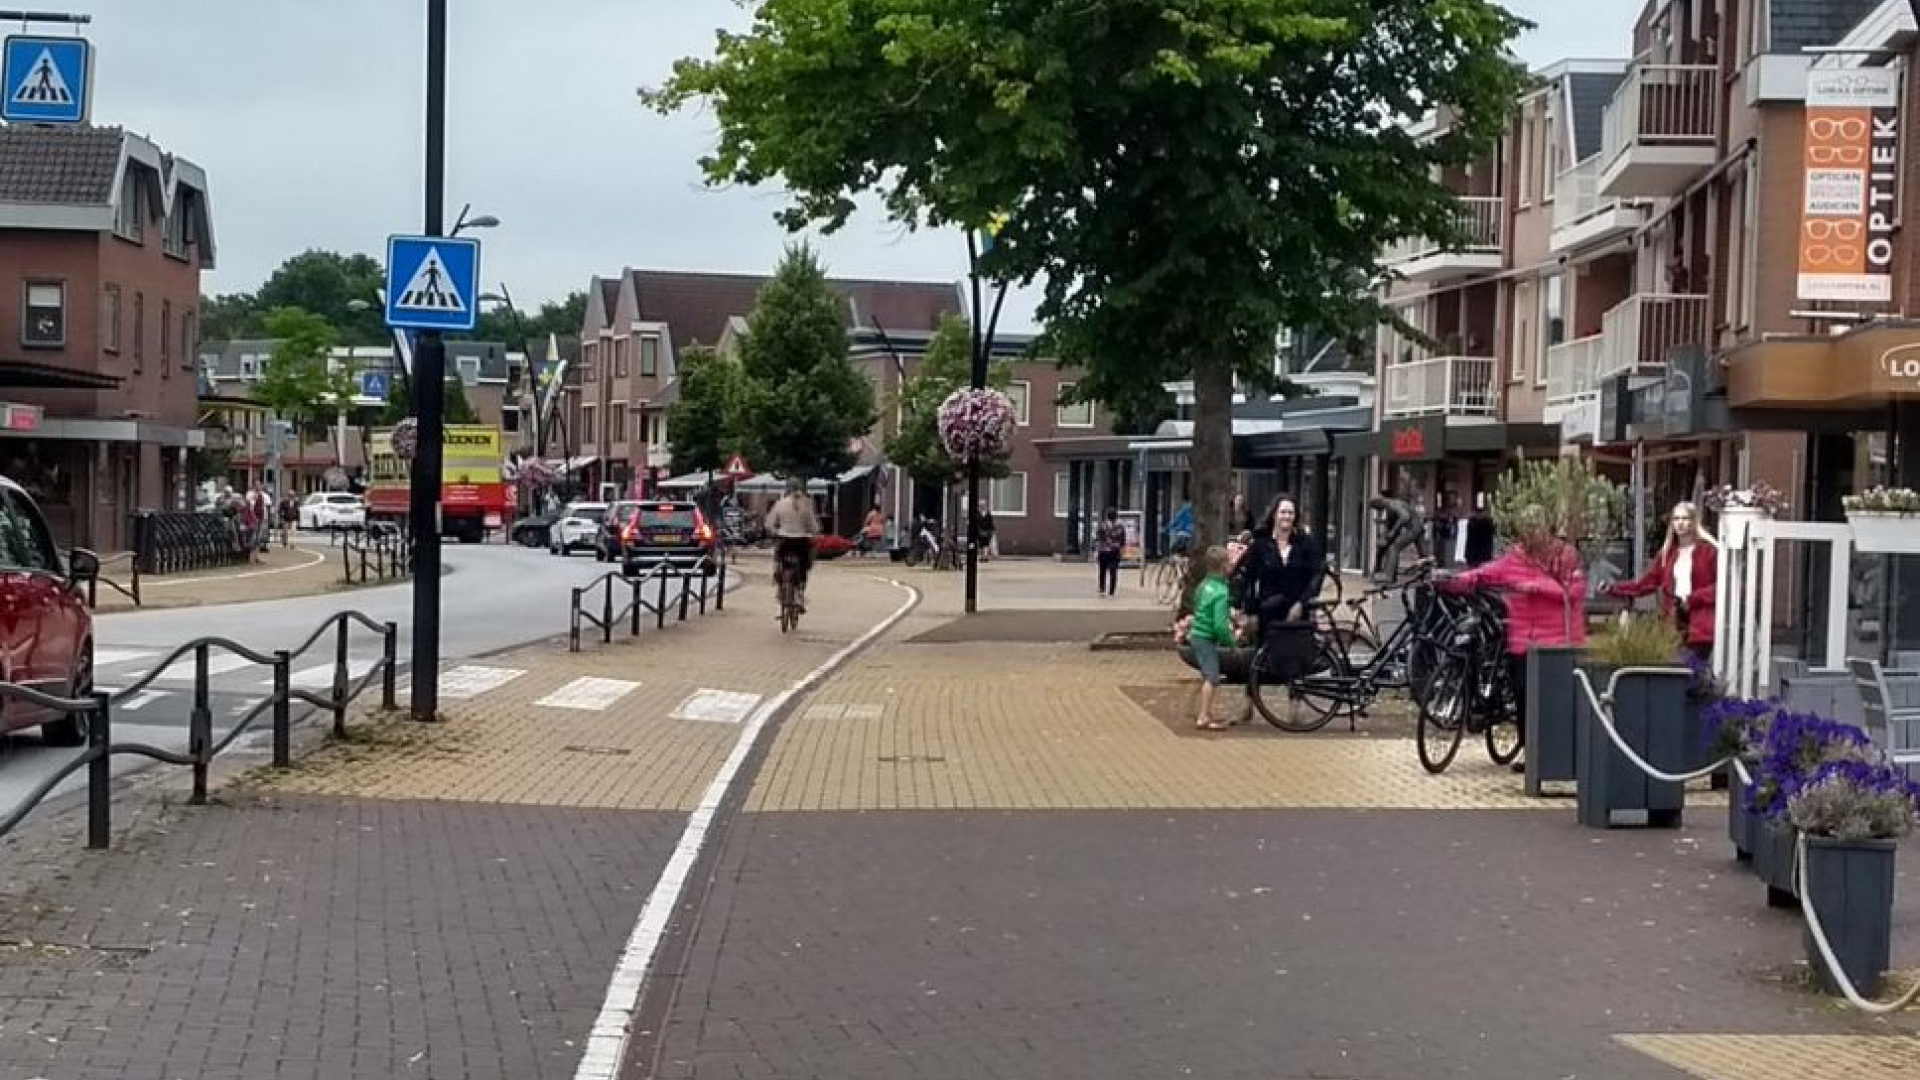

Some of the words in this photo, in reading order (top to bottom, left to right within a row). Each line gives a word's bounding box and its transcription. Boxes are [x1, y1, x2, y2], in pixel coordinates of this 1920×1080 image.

[1810, 172, 1861, 182] OPTICIEN
[1867, 116, 1897, 265] OPTIEK
[1809, 200, 1860, 210] AUDICIEN
